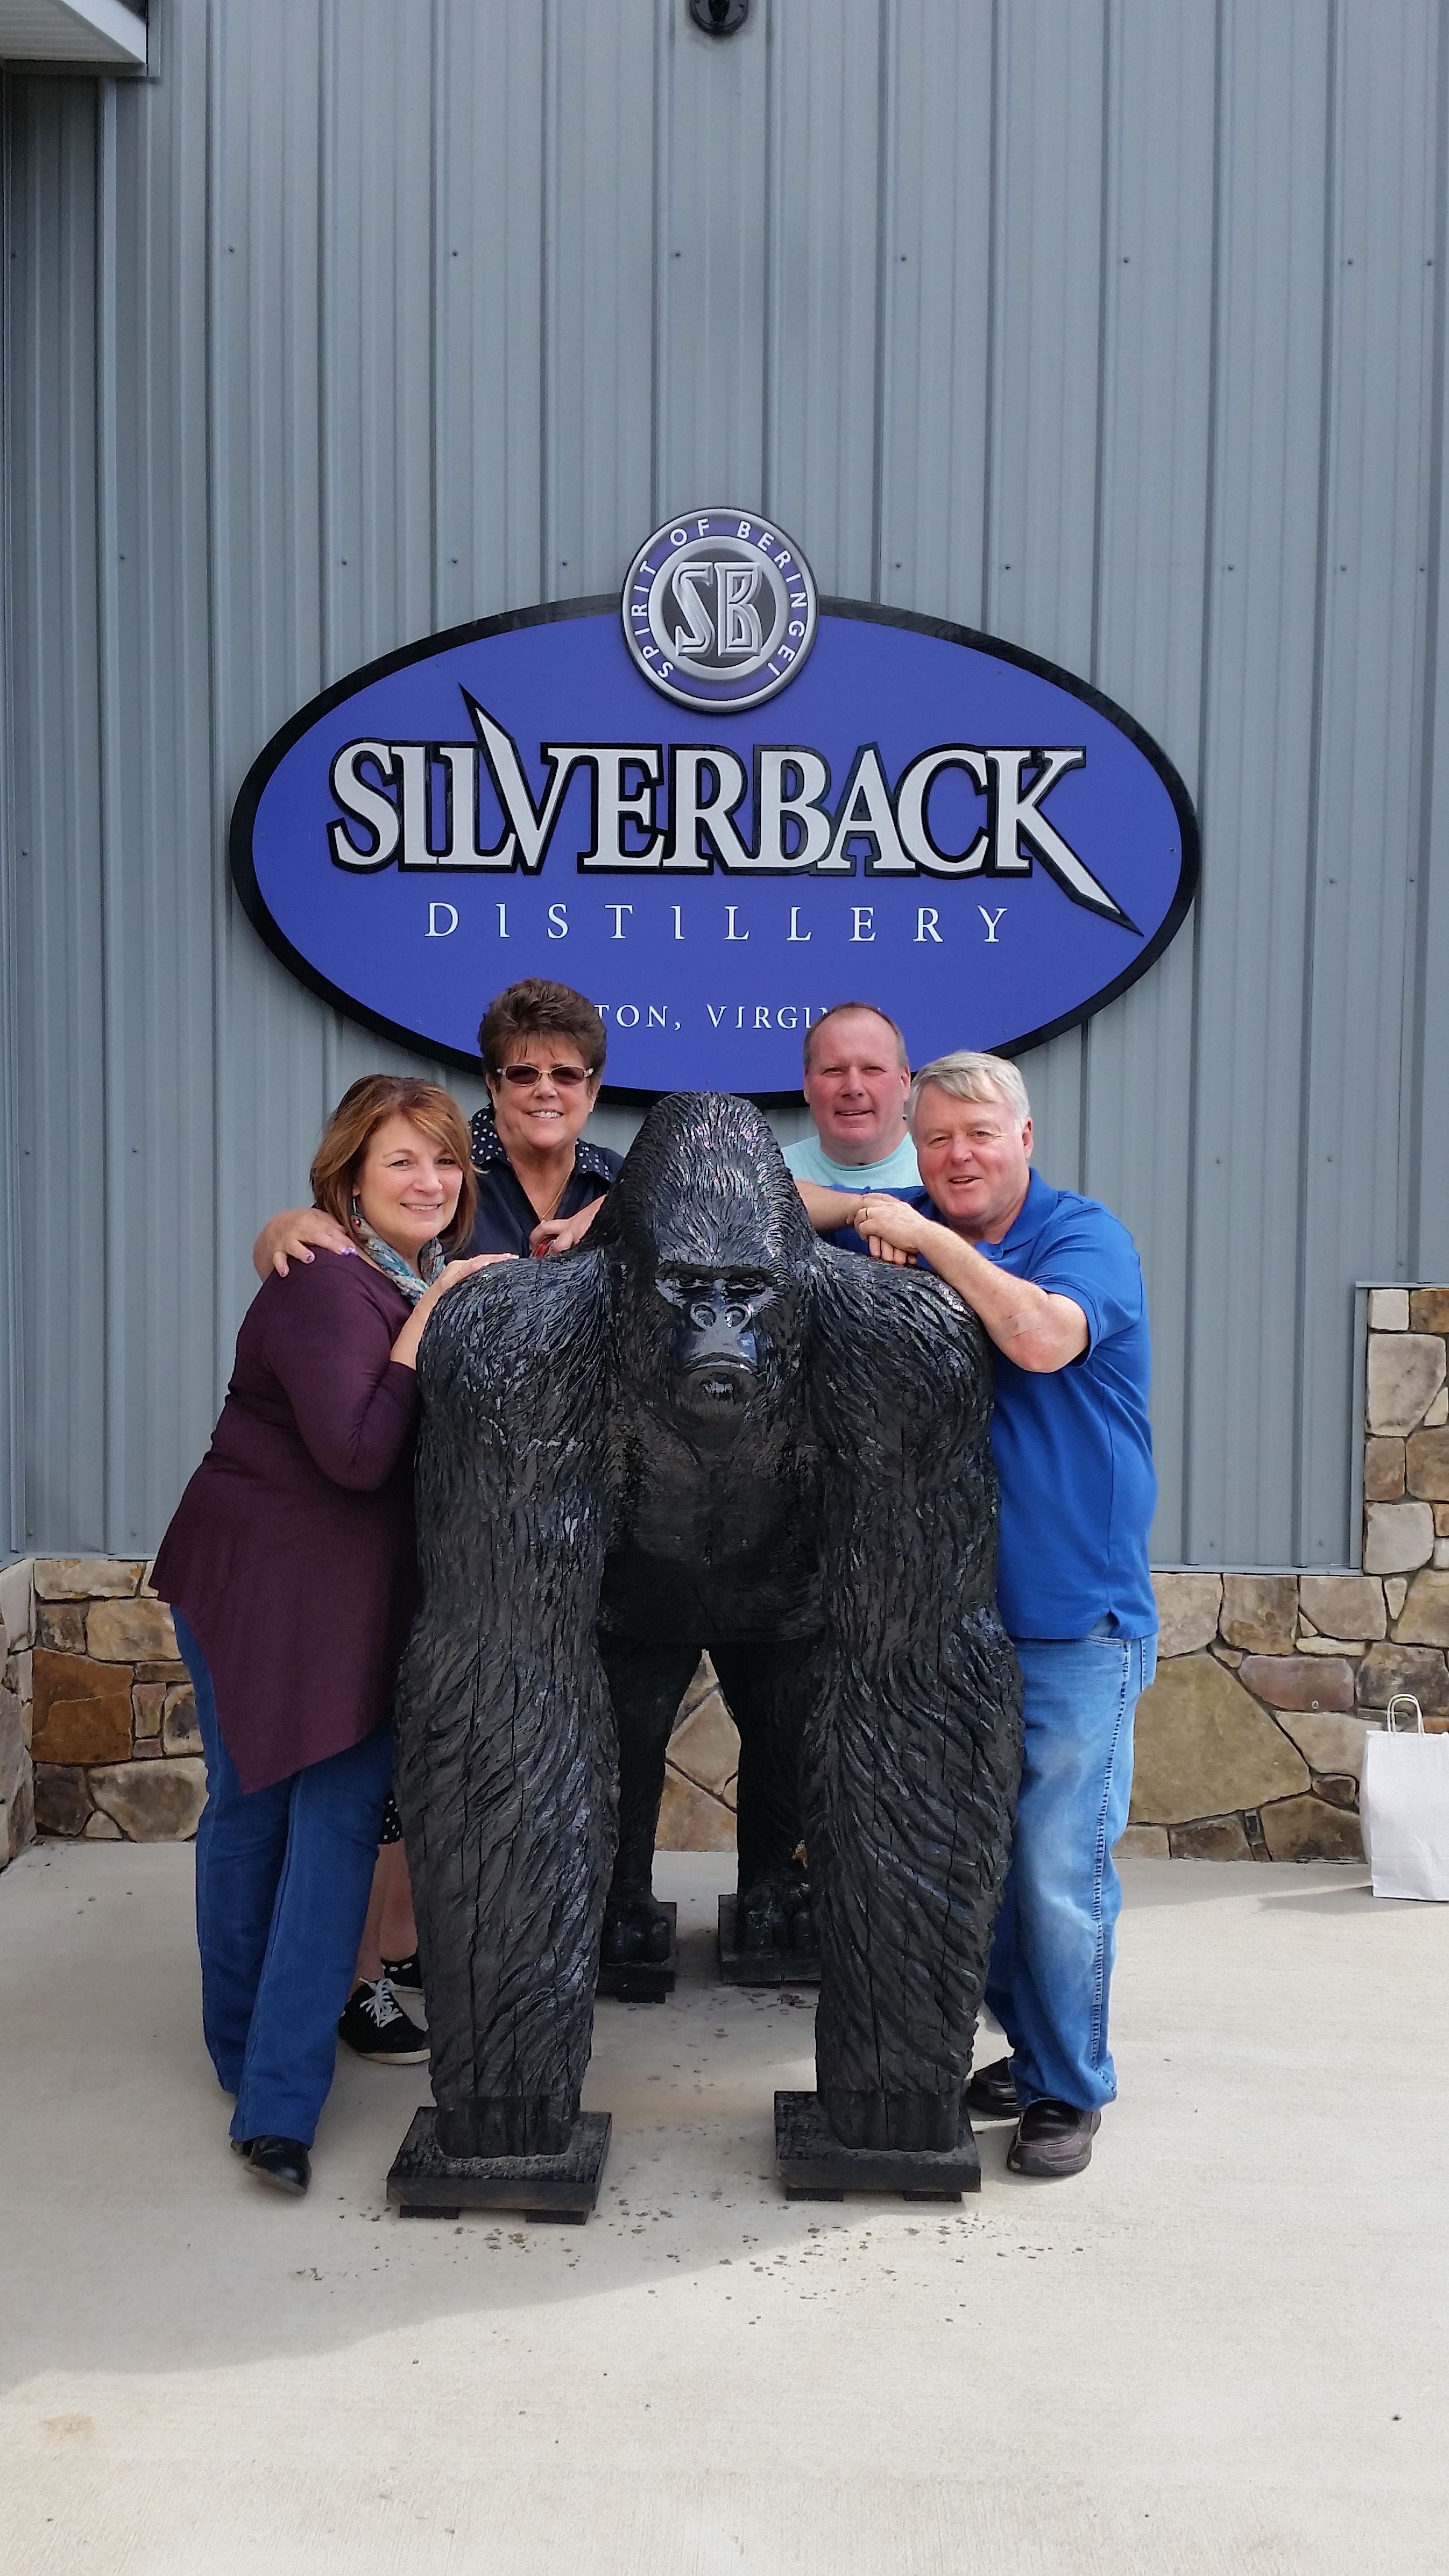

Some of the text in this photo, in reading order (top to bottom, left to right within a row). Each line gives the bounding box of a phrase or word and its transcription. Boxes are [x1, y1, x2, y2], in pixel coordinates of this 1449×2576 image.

[631, 518, 807, 678] SPIRIT OF BERINGEI
[672, 561, 763, 657] SB
[333, 706, 1122, 916] SILVERBACK
[425, 902, 1009, 944] DISTILLERY
[594, 1004, 882, 1030] TON, VIRGI
